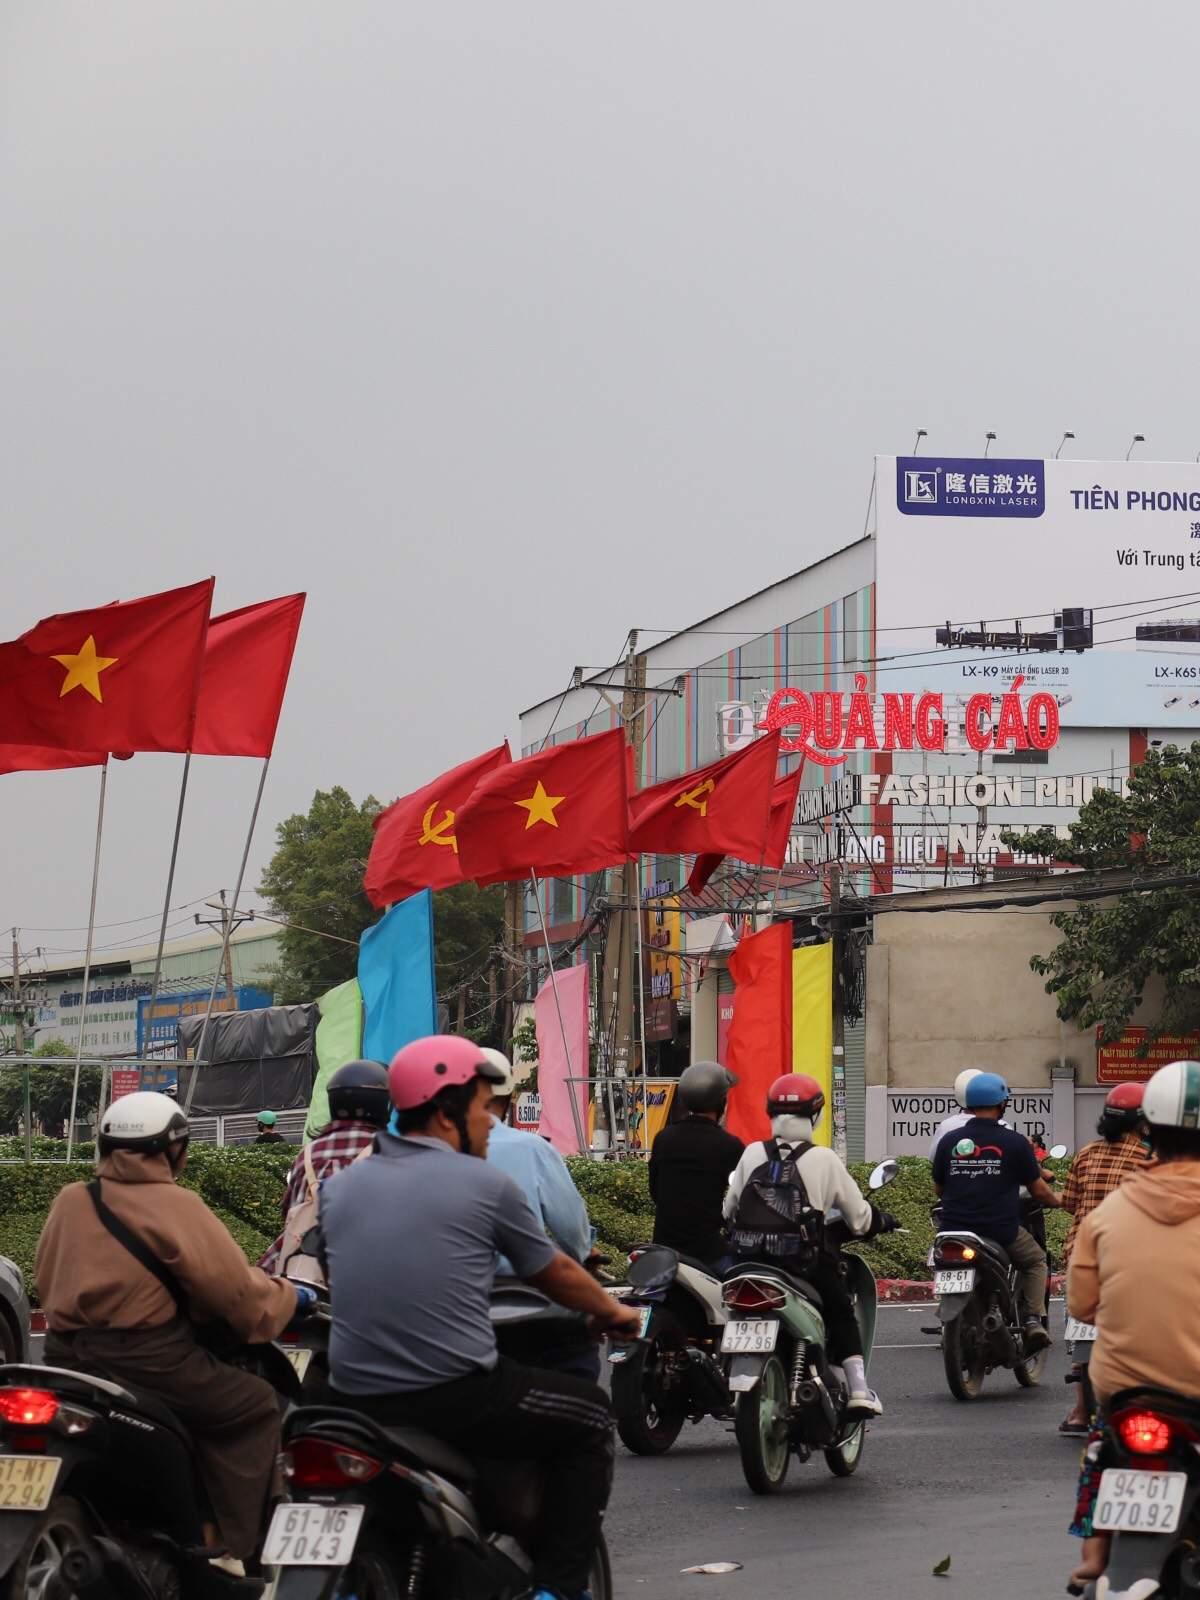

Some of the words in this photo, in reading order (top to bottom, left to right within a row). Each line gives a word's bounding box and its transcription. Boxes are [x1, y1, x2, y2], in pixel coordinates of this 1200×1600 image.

[944, 472, 1038, 495] 隆信激光
[945, 496, 996, 506] LONGXIN
[1000, 497, 1038, 507] LASER
[1070, 484, 1119, 511] TIÊN
[1116, 550, 1139, 567] Với
[1142, 551, 1185, 571] Trung
[962, 666, 999, 677] LX-K9
[1001, 665, 1013, 675] MÁY
[1041, 667, 1060, 675] LASER
[1155, 667, 1197, 678] LX-K6S
[756, 673, 945, 766] QUẢNG
[965, 675, 1060, 751] CÁO
[860, 774, 1022, 806] FASHION
[840, 829, 885, 864] ẢNG
[727, 1336, 772, 1350] 377.96
[284, 1508, 349, 1534] 61-N6
[1099, 1501, 1174, 1529] 070.92
[275, 1535, 342, 1561] 7043
